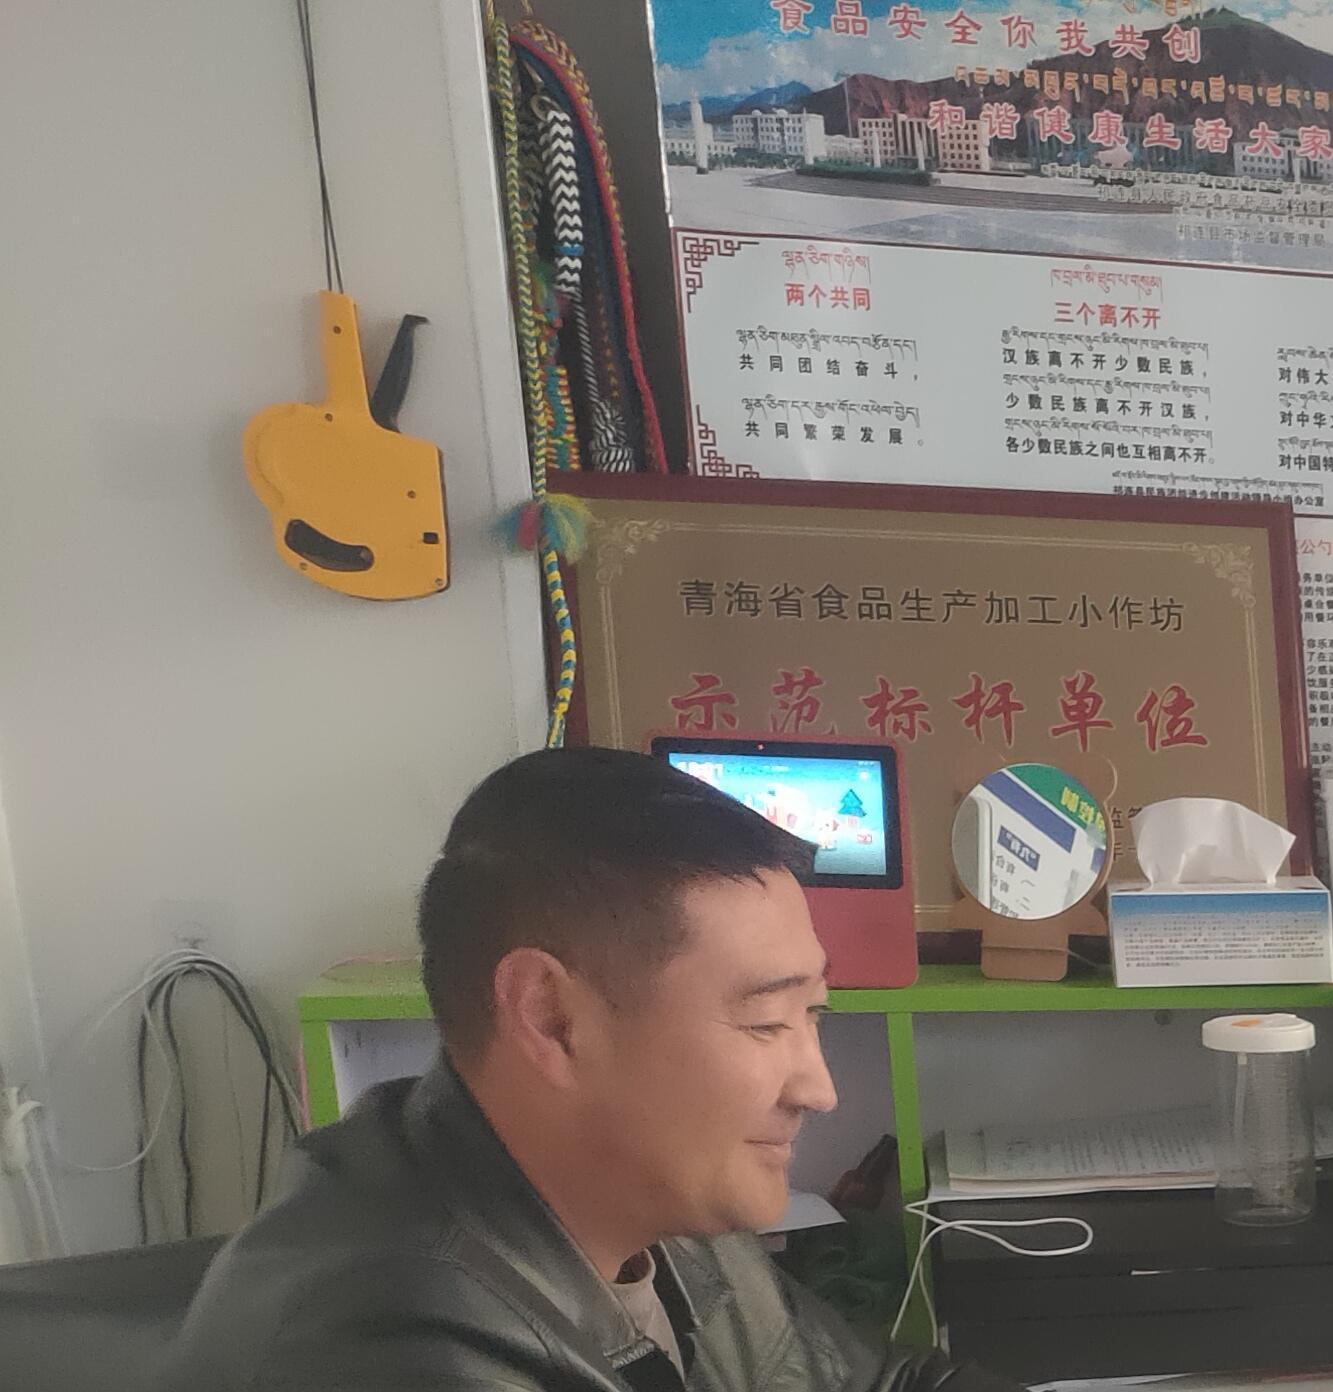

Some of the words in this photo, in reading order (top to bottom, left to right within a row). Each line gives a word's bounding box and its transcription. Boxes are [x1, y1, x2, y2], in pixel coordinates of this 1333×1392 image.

[773, 0, 1201, 63] 食品安全你我共创
[785, 283, 872, 312] 两个共同
[1054, 302, 1161, 330] 三个离不开
[1002, 347, 1207, 378] 汉族离不开少数民族，
[1005, 391, 1209, 422] 少数民族离不开汉族，
[1006, 436, 1214, 465] 各少数民族之间也互相离不开。
[680, 578, 1185, 633] 青海省食品生产加工小作坊
[671, 664, 1209, 753] 示范标杆单位
